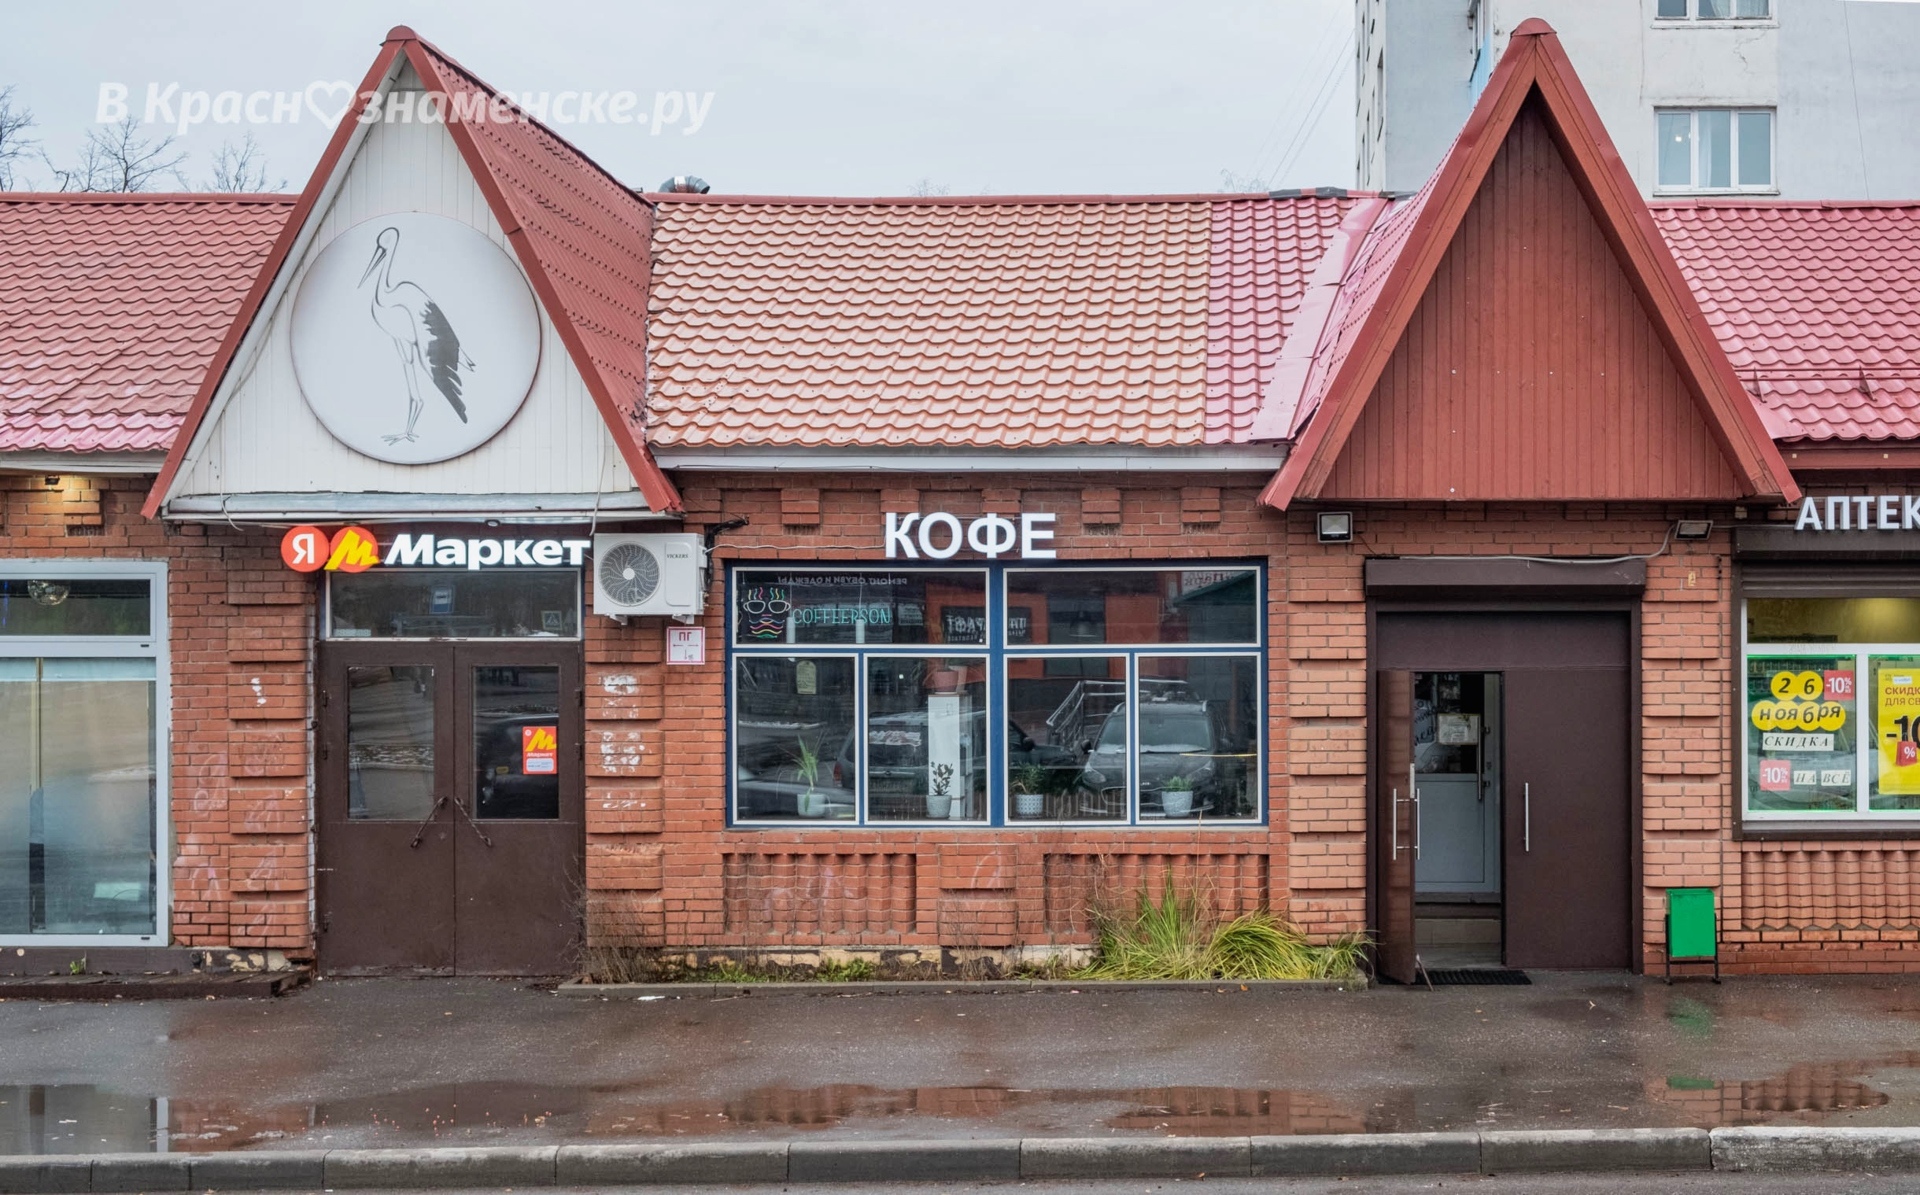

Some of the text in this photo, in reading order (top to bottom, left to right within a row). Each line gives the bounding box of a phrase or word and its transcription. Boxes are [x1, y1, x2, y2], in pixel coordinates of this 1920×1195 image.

[1794, 494, 1920, 531] АПТЕК
[885, 511, 1057, 560] КОФЕ
[384, 533, 592, 571] Маркет
[679, 631, 693, 642] ПГ
[1884, 697, 1906, 707] ДЛЯ
[1759, 705, 1842, 724] ноября
[1764, 736, 1829, 749] СКИДКА
[1795, 770, 1850, 784] НА ВСЁ
